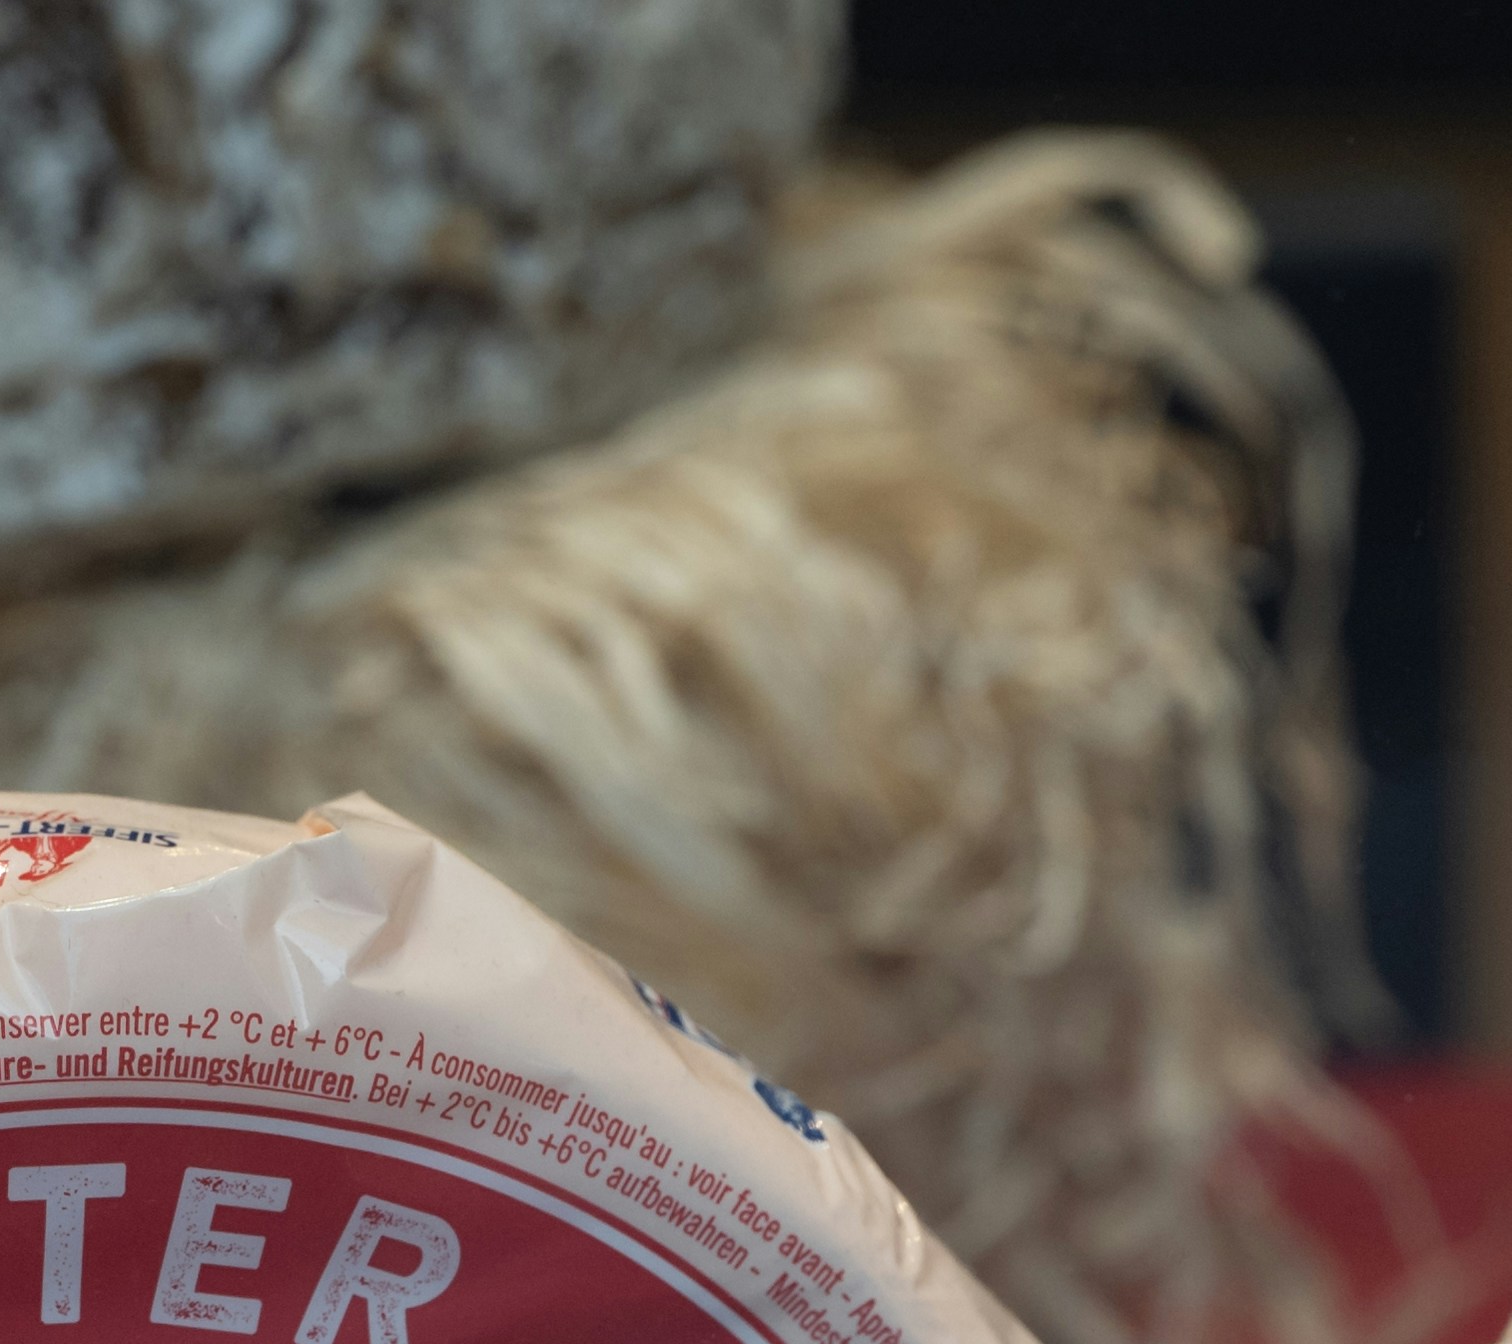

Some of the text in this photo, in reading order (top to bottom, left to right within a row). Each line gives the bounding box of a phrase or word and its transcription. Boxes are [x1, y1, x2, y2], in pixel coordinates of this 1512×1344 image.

[10, 819, 182, 849] SIFFERT
[56, 1046, 108, 1078] und
[117, 1046, 358, 1102] Reifungskulturen.
[367, 1073, 412, 1109] Bei
[440, 1091, 492, 1130] 2°C
[492, 1107, 533, 1146] bis
[537, 1133, 607, 1179] +6°C
[606, 1166, 750, 1271] aufbewahren
[99, 1005, 169, 1036] entre
[178, 1007, 220, 1040] +2
[229, 1010, 264, 1044] °C
[270, 1018, 298, 1049] et
[334, 1024, 384, 1062] 6°C
[406, 1031, 425, 1071] À
[431, 1052, 569, 1115] consommer
[564, 1093, 673, 1170] jusqu'au
[687, 1163, 734, 1205] voir
[731, 1189, 780, 1242] face
[779, 1233, 845, 1295] avant
